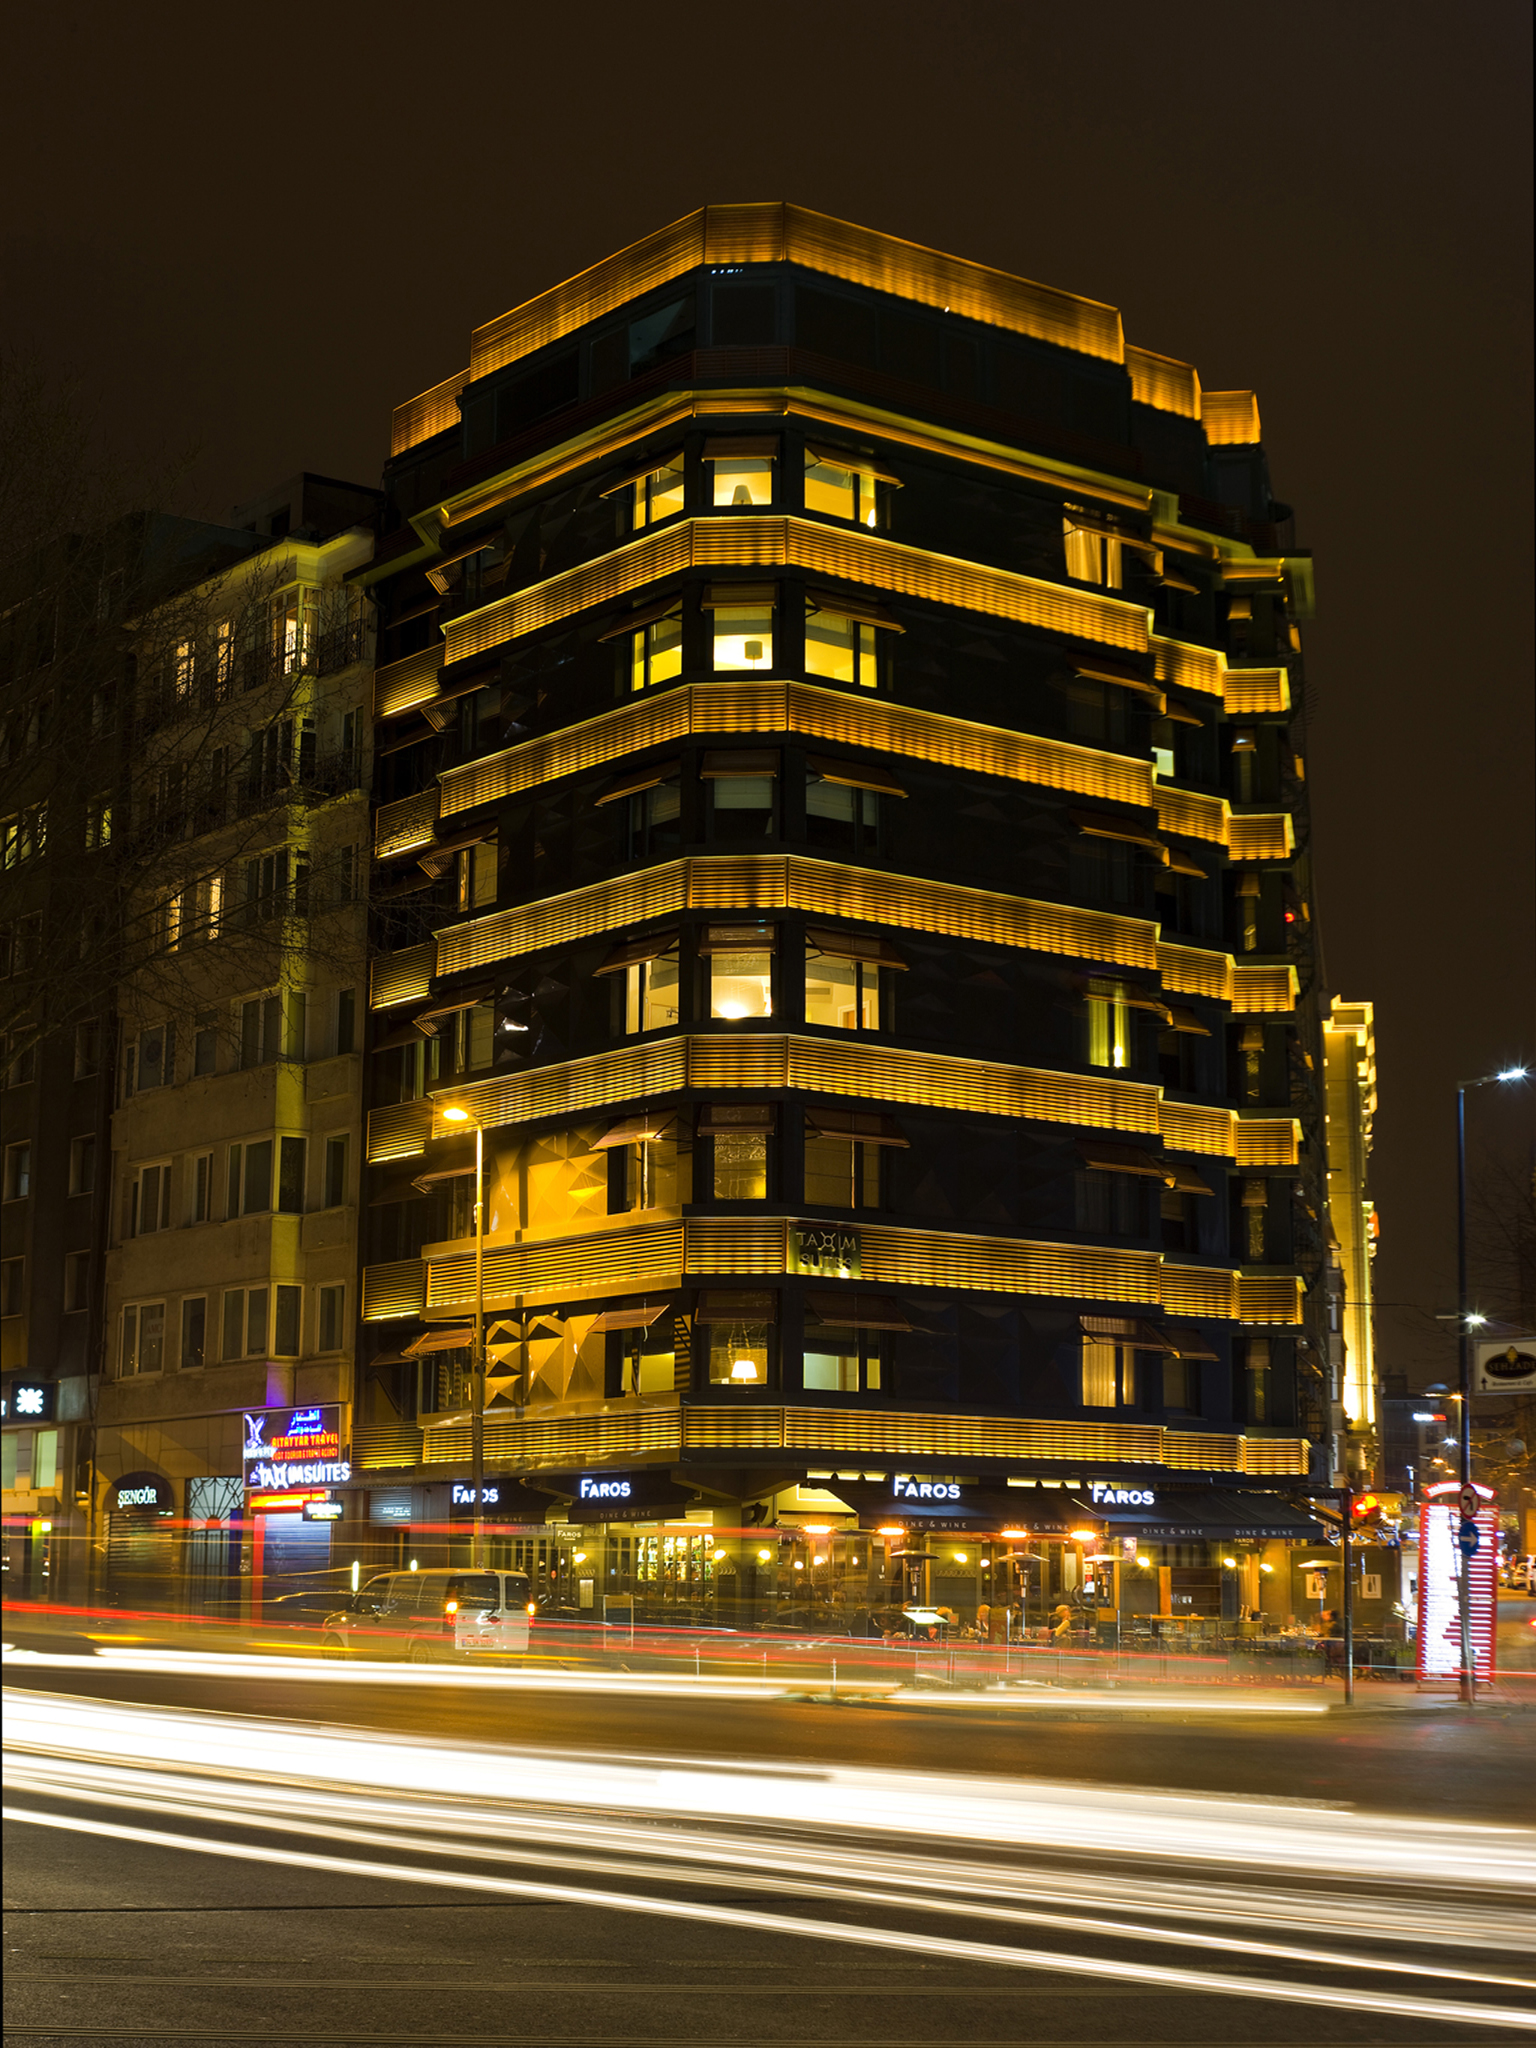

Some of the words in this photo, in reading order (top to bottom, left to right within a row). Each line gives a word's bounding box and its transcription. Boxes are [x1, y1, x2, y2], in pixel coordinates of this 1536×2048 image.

[795, 1231, 857, 1251] TAXIM
[800, 1252, 853, 1271] SUITES
[271, 1435, 309, 1448] ALTAYYAR
[311, 1433, 339, 1446] TRAVEL
[581, 1478, 632, 1498] FAROS
[894, 1475, 961, 1499] FAROS
[1092, 1482, 1155, 1505] FAROS
[622, 1510, 627, 1518] &
[630, 1510, 651, 1518] WINE
[898, 1520, 924, 1528] DINE
[929, 1520, 935, 1528] &
[940, 1521, 967, 1529] WINE
[1033, 1522, 1040, 1530] &
[557, 1530, 582, 1538] FAROS
[1142, 1527, 1165, 1535] DINE
[1169, 1527, 1176, 1535] &
[1180, 1528, 1203, 1536] WINE
[1235, 1529, 1257, 1537] DINE
[1261, 1529, 1267, 1537] &
[1270, 1529, 1293, 1537] WINE
